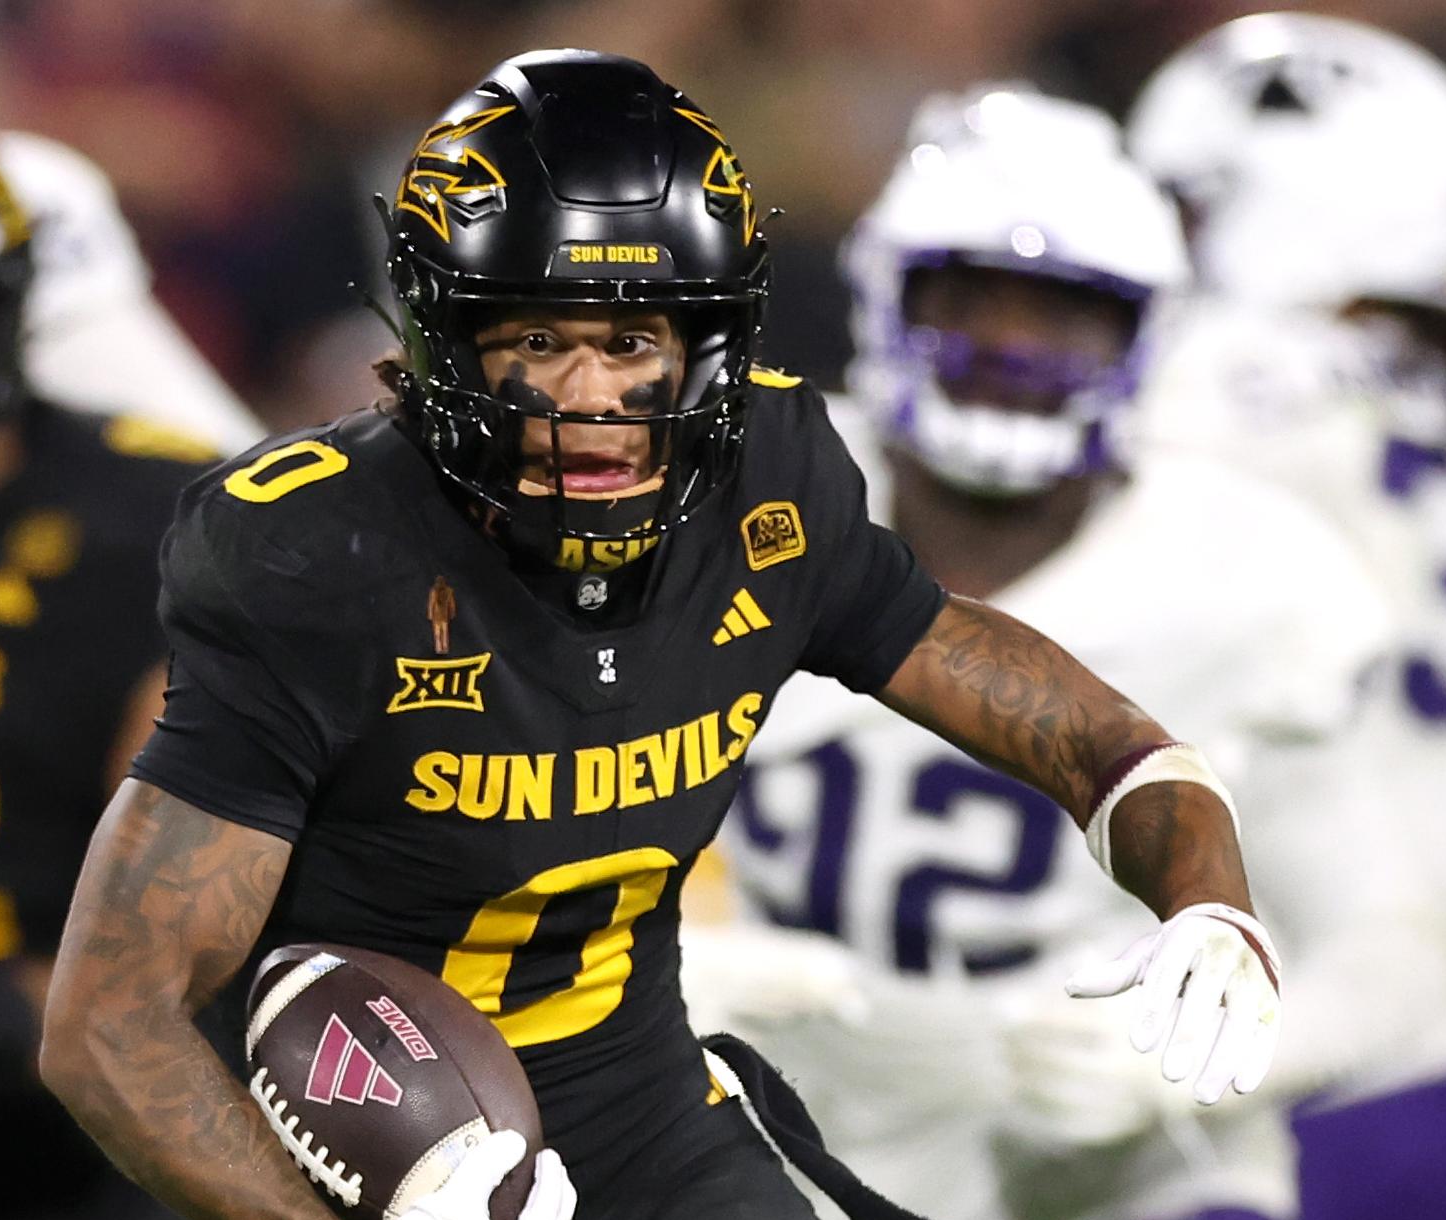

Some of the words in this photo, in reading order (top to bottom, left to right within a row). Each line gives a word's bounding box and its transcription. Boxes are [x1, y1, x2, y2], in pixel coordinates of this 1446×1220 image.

[569, 246, 604, 263] SUN
[607, 246, 659, 264] DEVILS
[224, 439, 350, 503] 0
[388, 653, 491, 712] XII
[404, 751, 557, 821] SUN
[574, 692, 763, 816] DEVILS
[738, 736, 1066, 976] 92
[441, 847, 680, 1048] 0
[365, 995, 439, 1062] DIME
